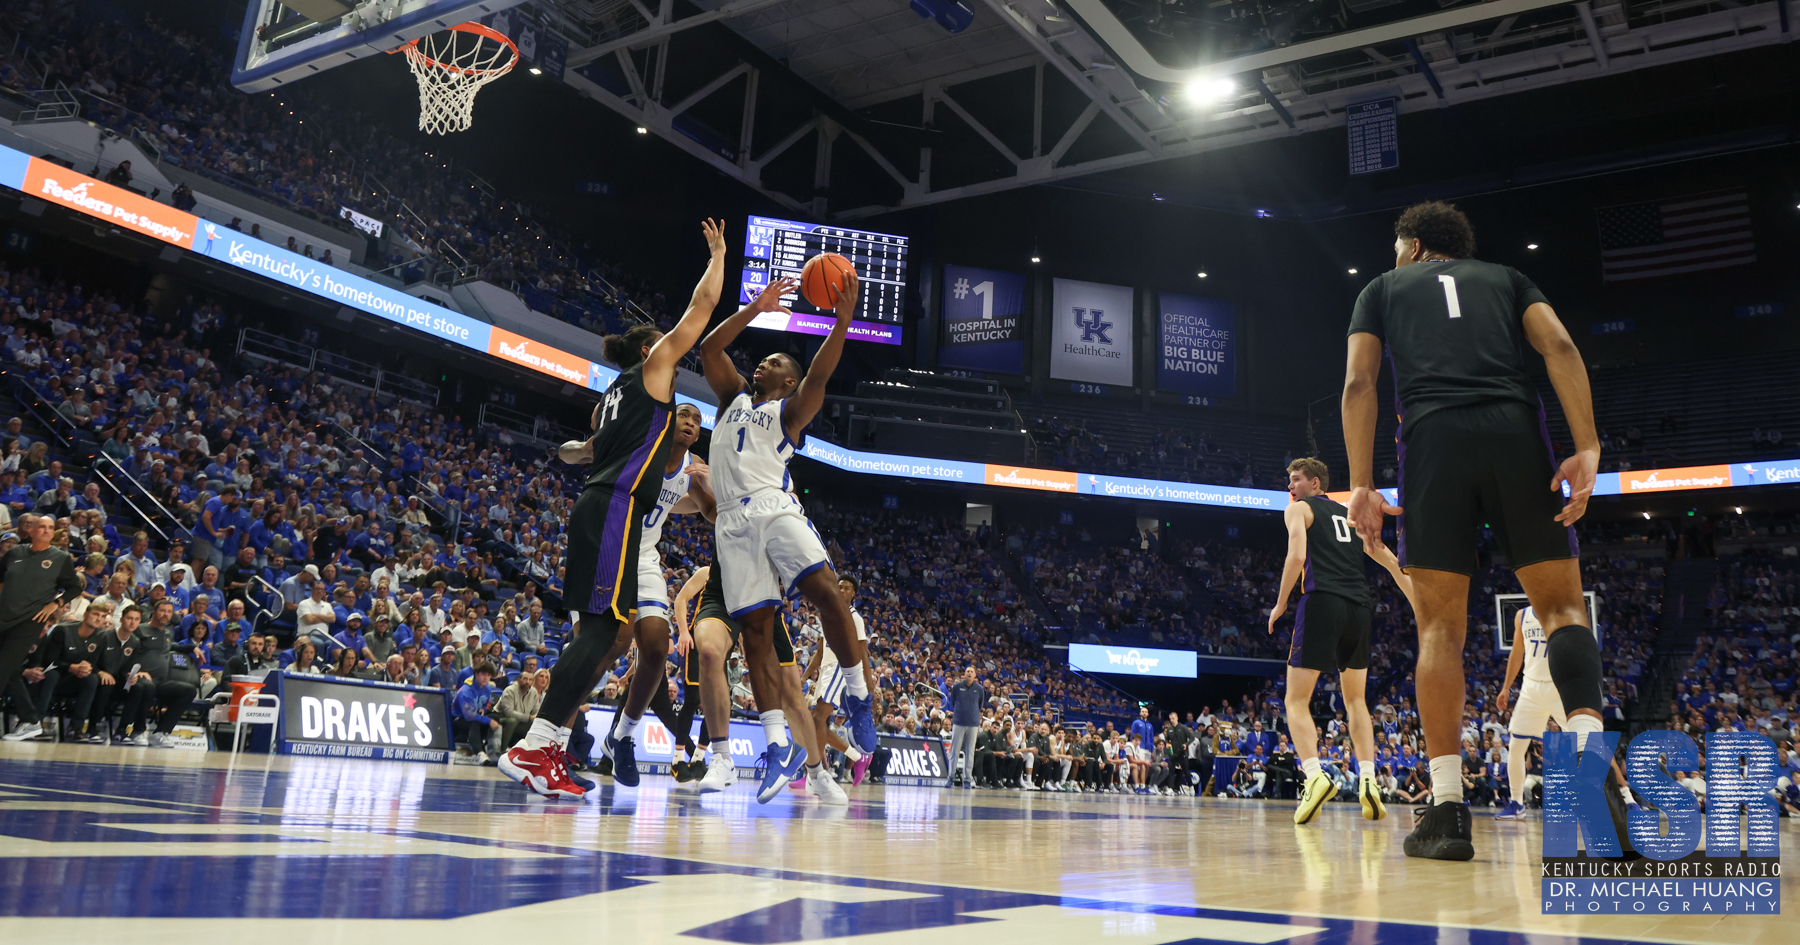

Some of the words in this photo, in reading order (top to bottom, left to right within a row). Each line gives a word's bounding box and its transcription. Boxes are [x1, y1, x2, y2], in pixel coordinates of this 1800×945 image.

[586, 182, 608, 194] 234
[42, 178, 113, 216] Feeders
[113, 206, 138, 225] Pet
[139, 216, 184, 242] Supply
[8, 232, 28, 250] 31
[784, 239, 806, 247] ROBINSON
[753, 246, 764, 257] 34
[748, 260, 766, 269] 3:14
[750, 272, 762, 282] 20
[228, 240, 322, 288] Kentucky's
[323, 274, 405, 318] hometown
[406, 308, 432, 327] pet
[433, 316, 470, 340] store
[1438, 275, 1460, 318] 1
[953, 277, 994, 320] #1
[1748, 304, 1772, 316] 240
[948, 318, 1002, 333] HOSPITAL
[1004, 318, 1016, 328] IN
[1164, 313, 1210, 328] OFFICIAL
[1602, 321, 1625, 332] 240
[303, 328, 318, 342] 32
[796, 320, 835, 331] MARKETPLA
[871, 330, 892, 338] PLANS
[952, 329, 1012, 344] KENTUCKY
[1164, 324, 1230, 340] HEALTHCARE
[1164, 335, 1210, 349] PARTNER
[1211, 340, 1227, 350] OF
[1063, 342, 1121, 360] HealthCare
[1164, 346, 1190, 360] BIG
[1190, 348, 1225, 362] BLUE
[498, 342, 540, 366] Feeders
[540, 358, 556, 370] Pet
[556, 364, 583, 382] Supply
[1164, 358, 1218, 375] NATION
[1079, 384, 1102, 394] 236
[504, 393, 515, 405] 33
[1188, 396, 1209, 406] 236
[736, 426, 746, 452] 1
[807, 442, 847, 466] Kentucky's
[848, 456, 910, 473] hometown
[912, 464, 931, 476] pet
[933, 466, 963, 478] store
[994, 472, 1032, 486] Feeders
[1032, 478, 1046, 487] Pet
[1046, 480, 1072, 491] Supply
[1630, 478, 1674, 490] Feeders
[1675, 478, 1692, 487] Pet
[1692, 476, 1724, 486] Supply
[1105, 480, 1164, 499] Kentucky's
[1166, 488, 1222, 504] hometown
[1224, 494, 1241, 506] pet
[1243, 494, 1270, 506] store
[886, 498, 897, 506] 35
[1061, 514, 1073, 522] 36
[1332, 514, 1352, 542] 0
[1524, 628, 1546, 639] KENTU
[1530, 640, 1548, 658] 77
[1122, 650, 1160, 673] Kroger
[292, 742, 327, 756] KENTUCKY
[328, 744, 346, 756] FARM
[347, 746, 373, 758] BUREAU
[382, 748, 392, 759] BIG
[392, 749, 404, 759] ON
[405, 750, 445, 762] COMMITMENT
